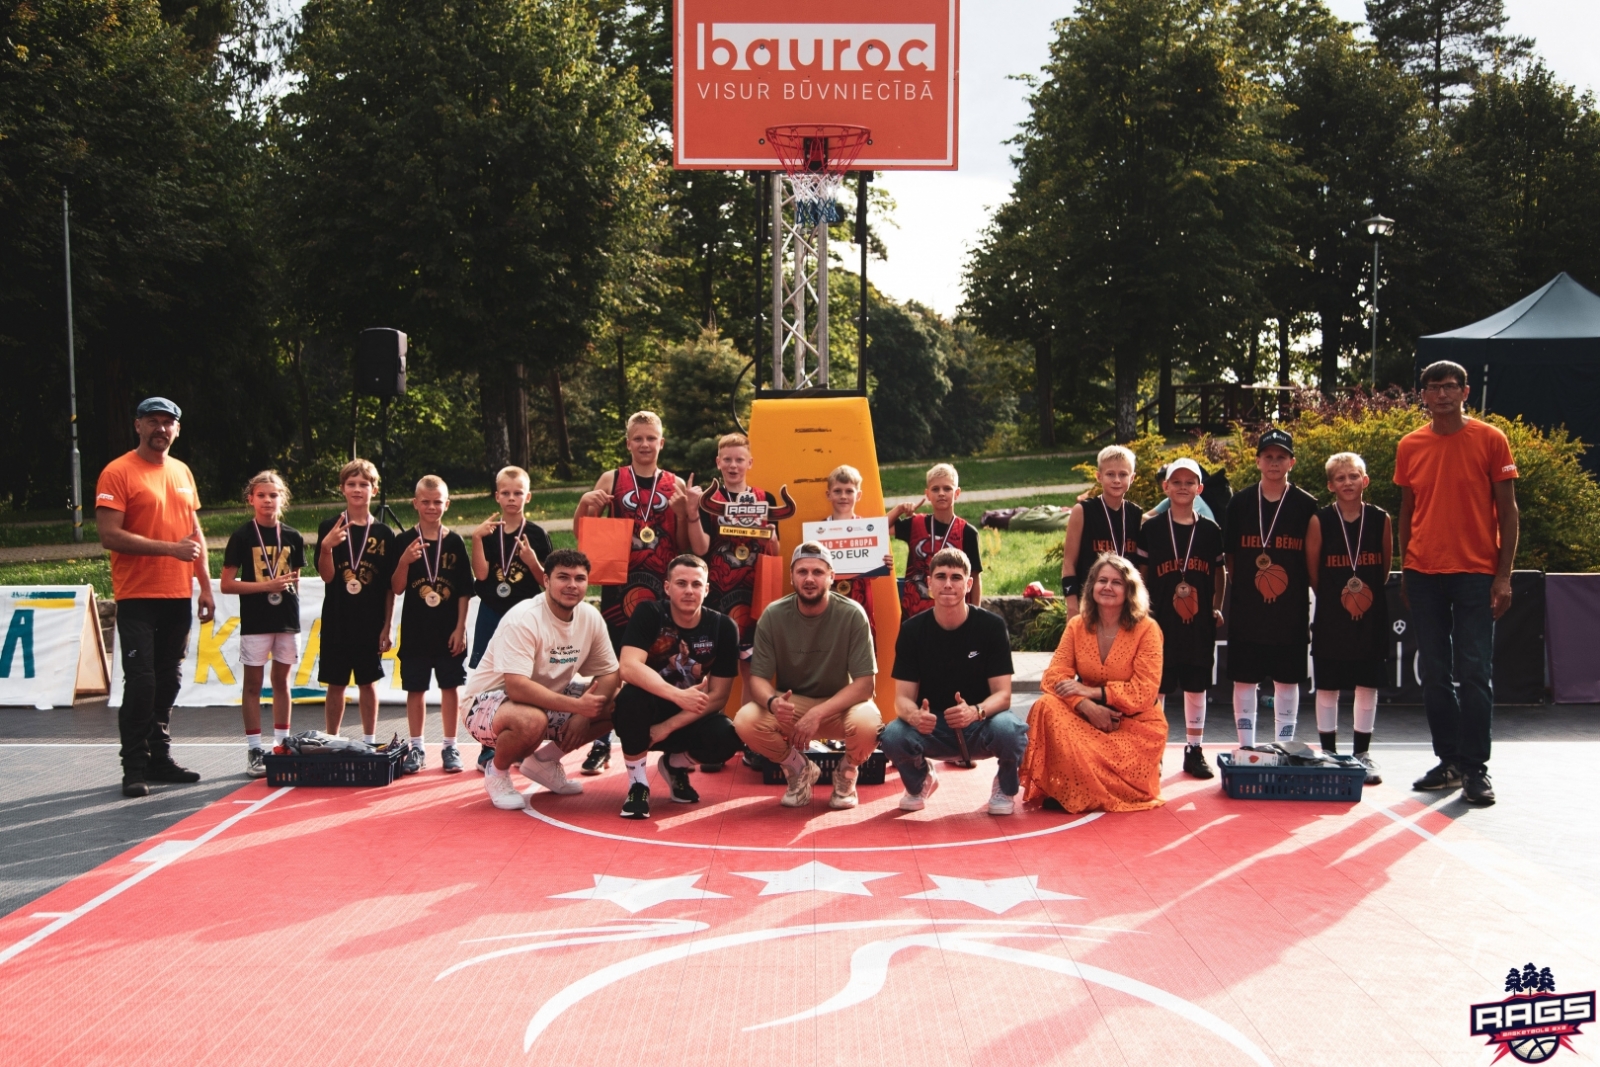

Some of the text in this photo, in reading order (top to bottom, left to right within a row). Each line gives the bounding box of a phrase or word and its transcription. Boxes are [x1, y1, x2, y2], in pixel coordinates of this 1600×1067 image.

[697, 23, 936, 71] bauroc
[697, 79, 934, 101] VISUR BŪVNIECĪBĀ
[729, 505, 766, 515] RAGS
[367, 536, 385, 556] 24
[821, 540, 834, 549] 10
[850, 537, 873, 547] GRUPA
[1241, 534, 1272, 549] LIELE
[441, 552, 457, 570] 12
[846, 548, 870, 559] EUR
